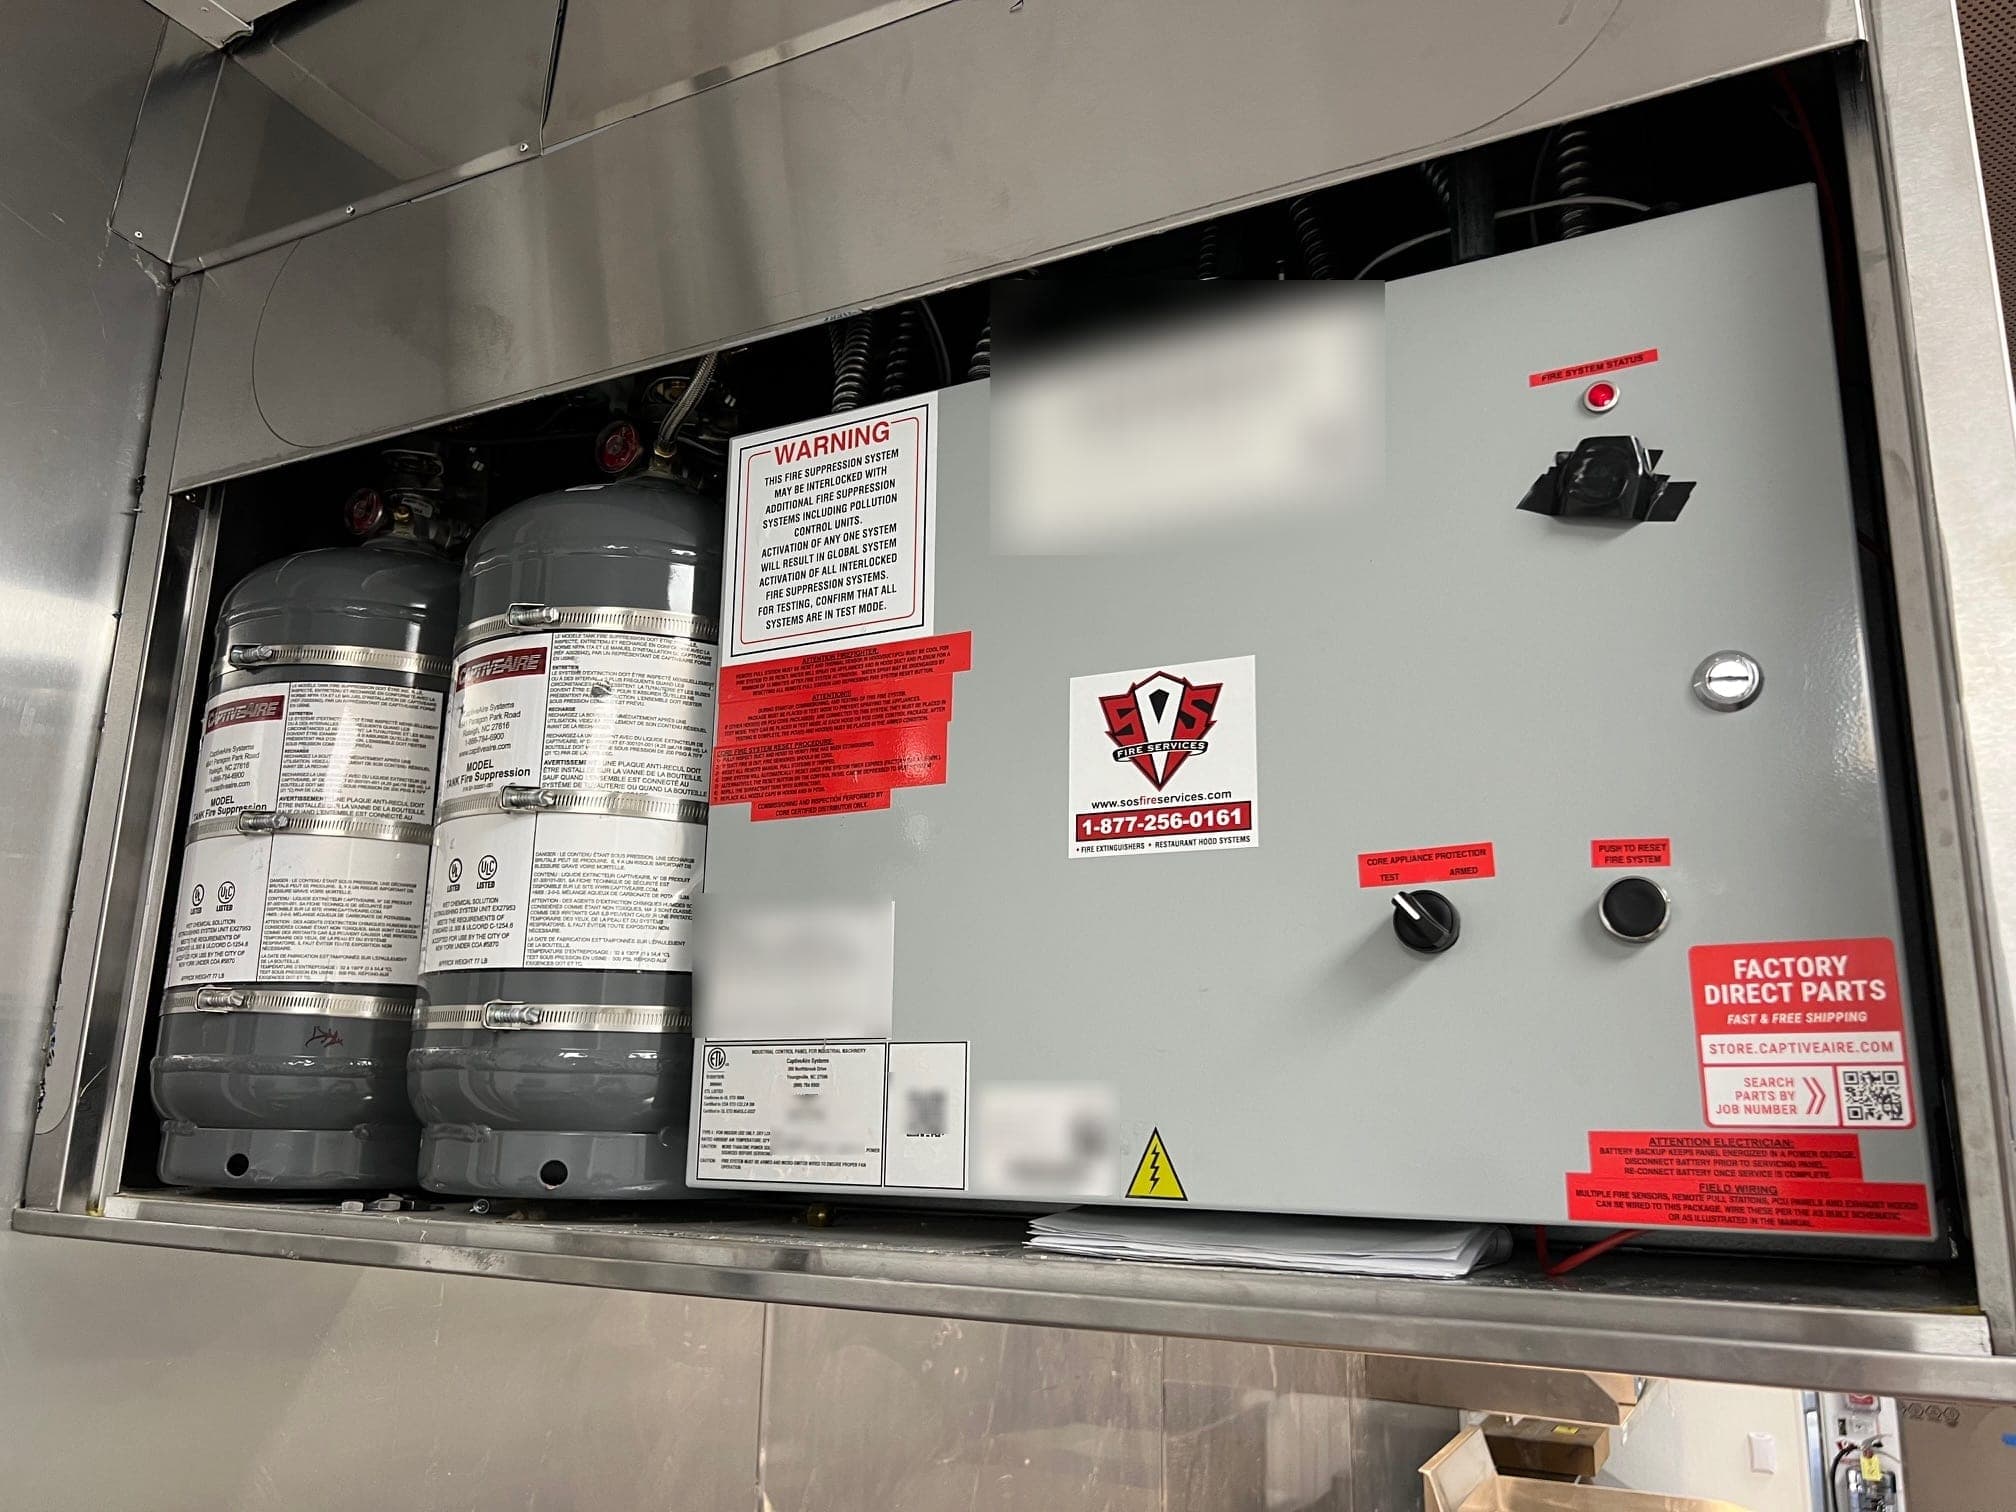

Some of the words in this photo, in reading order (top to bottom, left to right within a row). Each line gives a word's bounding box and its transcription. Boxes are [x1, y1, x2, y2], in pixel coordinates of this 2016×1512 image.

[1542, 370, 1564, 382] FIRE
[1565, 362, 1604, 377] SYSTEM
[1606, 354, 1644, 369] STATUS
[774, 421, 890, 466] WARNING
[765, 473, 782, 487] THIS
[785, 469, 802, 483] FIRE
[804, 456, 862, 478] SUPPRESSION
[864, 449, 899, 465] SYSTEM
[774, 486, 792, 498] MAY
[794, 483, 804, 494] BE
[806, 471, 862, 492] INTERLOCKED
[865, 465, 887, 480] WITH
[765, 495, 813, 515] ADDITIONAL
[816, 491, 834, 504] FIRE
[836, 479, 896, 500] SUPPRESSION
[762, 512, 800, 530] SYSTEMS
[803, 503, 847, 521] INCLUDING
[850, 493, 898, 512] POLLUTION
[794, 521, 832, 538] CONTROL
[835, 516, 863, 530] UNITS.
[761, 540, 809, 558] ACTIVATION
[811, 537, 822, 549] OF
[824, 534, 841, 547] ANY
[843, 530, 860, 543] ONE
[862, 523, 897, 539] SYSTEM
[761, 560, 780, 573] WILL
[782, 553, 813, 569] RESULT
[816, 551, 825, 563] IN
[827, 545, 860, 560] GLOBAL
[862, 538, 897, 554] SYSTEM
[759, 569, 806, 588] ACTIVATION
[809, 567, 820, 578] OF
[821, 564, 837, 576] ALL
[839, 553, 897, 573] INTERLOCKED
[765, 588, 783, 600] FIRE
[785, 578, 844, 597] SUPPRESSION
[846, 570, 889, 587] SYSTEMS.
[758, 605, 774, 617] FOR
[776, 598, 813, 614] TESTING,
[816, 591, 855, 607] CONFIRM
[857, 587, 878, 600] THAT
[880, 584, 897, 597] ALL
[765, 615, 803, 630] SYSTEMS
[806, 611, 823, 624] ARE
[824, 610, 833, 620] IN
[836, 606, 856, 619] TEST
[858, 601, 886, 615] MODE.
[489, 713, 502, 722] Park
[504, 711, 521, 719] Road
[1098, 671, 1223, 748] SOS
[481, 724, 490, 733] NC
[1117, 746, 1143, 759] FIRE
[1147, 741, 1205, 752] SERVICES
[466, 759, 494, 772] MODEL
[646, 763, 684, 772] ANTI-RECUL
[686, 766, 701, 774] DOIT
[460, 774, 473, 784] Fire
[474, 767, 530, 782] Suppression
[628, 776, 640, 784] EST
[674, 787, 708, 797] BOUTEILLE
[1092, 790, 1232, 809] www.sosfireservices.com
[210, 795, 234, 806] MODEL
[758, 799, 797, 810] COMMISSIONING
[799, 798, 810, 806] AND
[811, 795, 841, 804] INSPECTION
[842, 792, 875, 801] PERFORMED
[205, 809, 216, 817] Fire
[791, 806, 817, 815] CERTIFIED
[853, 802, 868, 810] ONLY.
[1082, 808, 1241, 835] 1-877-256-0161
[1096, 842, 1145, 853] EXTINGUISHERS
[1155, 839, 1197, 848] RESTAURANT
[1199, 837, 1217, 846] HOOD
[1219, 836, 1250, 844] SYSTEMS
[1599, 844, 1623, 853] PUSH
[1624, 844, 1636, 853] TO
[1638, 844, 1666, 852] RESET
[1367, 856, 1389, 866] CORE
[1390, 852, 1434, 864] APPLIANCE
[1435, 848, 1486, 861] PROTECTION
[1604, 855, 1624, 864] FIRE
[1626, 854, 1661, 864] SYSTEM
[481, 860, 494, 875] ULC
[1380, 872, 1399, 882] TEST
[1449, 866, 1478, 877] ARMED
[221, 886, 233, 899] ULC
[476, 881, 495, 889] LISTED
[1733, 955, 1848, 979] FACTORY
[1704, 982, 1792, 1005] DIRECT
[1801, 979, 1886, 1003] PARTS
[1727, 1013, 1757, 1025] FAST
[1760, 1013, 1768, 1024] &
[1772, 1013, 1802, 1024] FREE
[1806, 1012, 1868, 1023] SHIPPING
[1709, 1041, 1893, 1055] STORE.CAPTIVEAIRE.COM
[1743, 1077, 1794, 1088] SEARCH
[1736, 1091, 1775, 1101] PARTS
[1780, 1091, 1795, 1100] BY
[1716, 1104, 1739, 1114] JOB
[1744, 1104, 1797, 1114] NUMBER
[1649, 1137, 1710, 1147] ATTENTION
[1714, 1138, 1793, 1147] ELECTRICIAN:
[1600, 1147, 1632, 1155] BATTERY
[1635, 1148, 1665, 1156] BACKUP
[1668, 1148, 1693, 1156] KEEPS
[1722, 1149, 1767, 1157] ENERGIZED
[1624, 1158, 1674, 1166] DISCONNECT
[1713, 1159, 1737, 1167] PRIOR
[1752, 1160, 1796, 1168] SERVICING
[1624, 1167, 1673, 1176] RE-CONNECT
[1676, 1168, 1711, 1176] BATTERY
[1713, 1169, 1736, 1177] ONCE
[1576, 1189, 1611, 1199] MULTIPLE
[1612, 1191, 1630, 1199] FIRE
[1672, 1193, 1704, 1202] REMOTE
[1707, 1194, 1727, 1203] PULL
[1699, 1183, 1731, 1193] FIELD
[1735, 1184, 1777, 1194] WIRING
[1596, 1200, 1612, 1208] CAN
[1614, 1201, 1624, 1209] BE
[1625, 1201, 1650, 1210] WIRED
[1651, 1202, 1662, 1210] TO
[1664, 1203, 1681, 1211] THIS
[1725, 1205, 1745, 1214] WIRE
[1747, 1206, 1773, 1215] THESE
[1668, 1213, 1680, 1221] OR
[1682, 1214, 1693, 1222] AS
[1694, 1214, 1747, 1224] ILLUSTRATED
[1751, 1217, 1758, 1225] IN
[1759, 1217, 1775, 1225] THE
